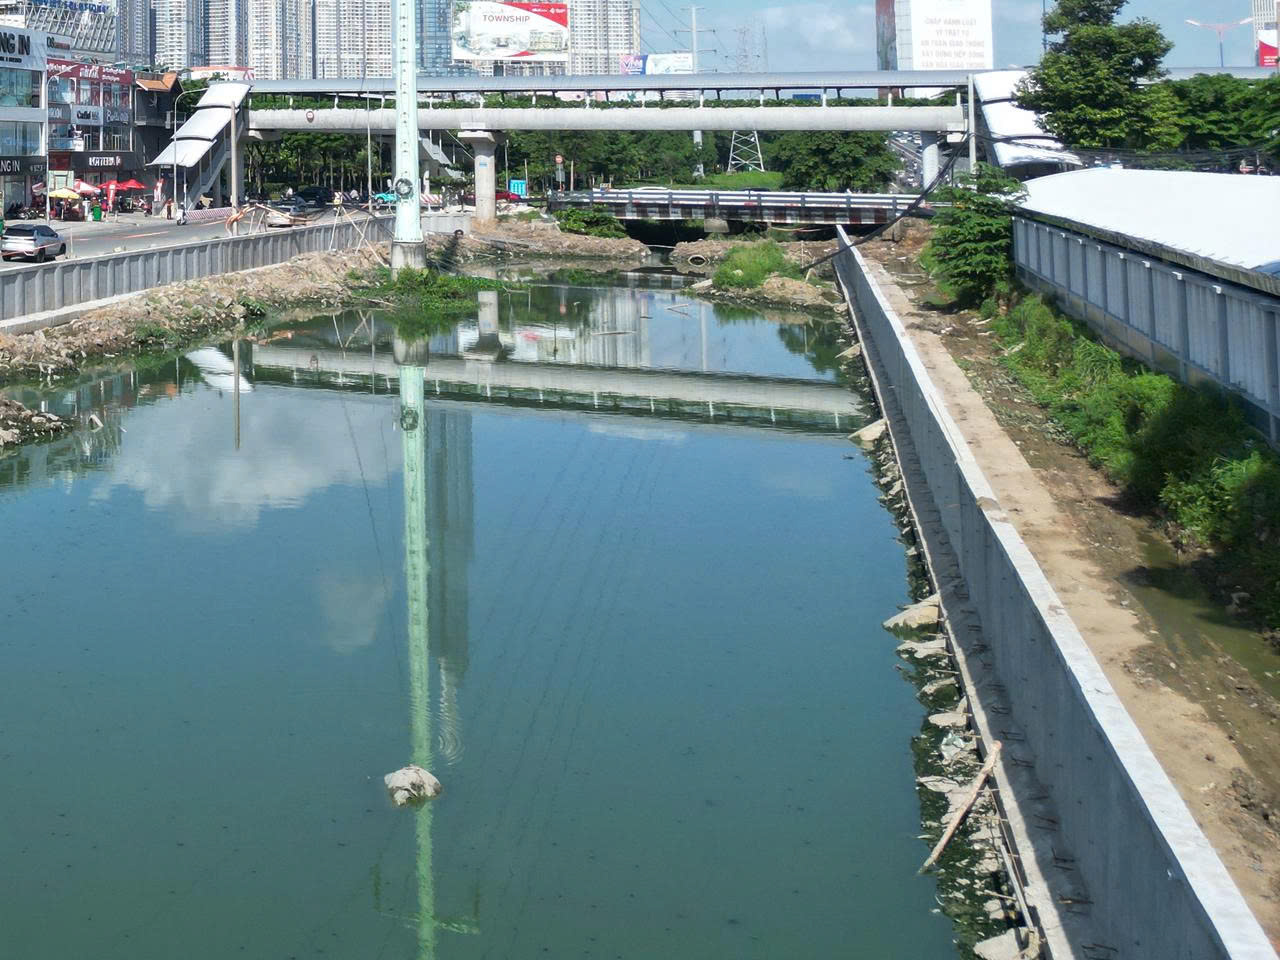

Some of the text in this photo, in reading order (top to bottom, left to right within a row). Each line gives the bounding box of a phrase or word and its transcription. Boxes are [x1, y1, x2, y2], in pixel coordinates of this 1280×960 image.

[483, 14, 530, 23] TOWNSHIP
[17, 34, 31, 56] IN
[12, 160, 21, 173] IN
